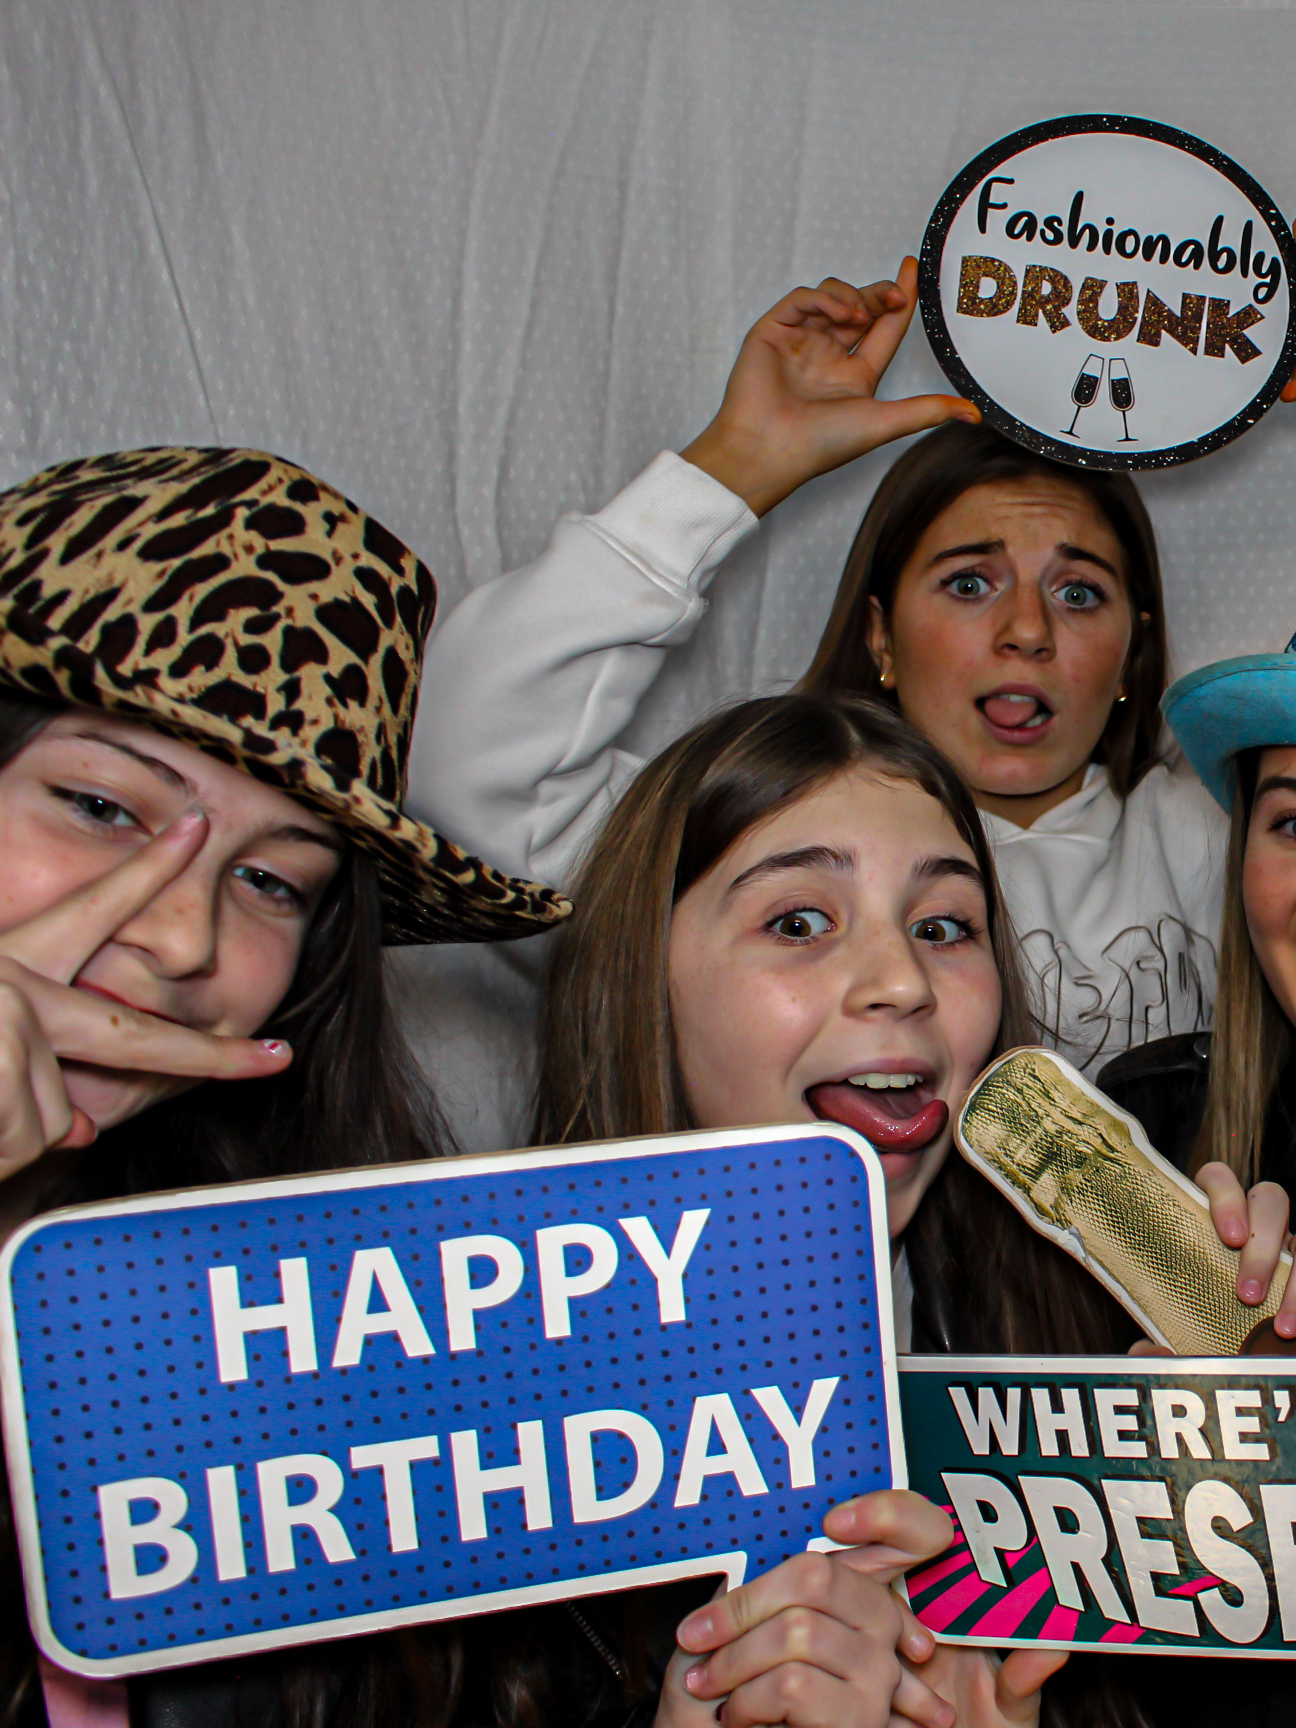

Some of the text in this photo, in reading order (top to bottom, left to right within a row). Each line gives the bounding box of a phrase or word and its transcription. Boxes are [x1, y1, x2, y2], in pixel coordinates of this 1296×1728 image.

[956, 254, 1266, 365] DRUNK
[976, 176, 1282, 305] Fashionably
[208, 1208, 712, 1383] HAPPY
[97, 1376, 841, 1600] BIRTHDAY
